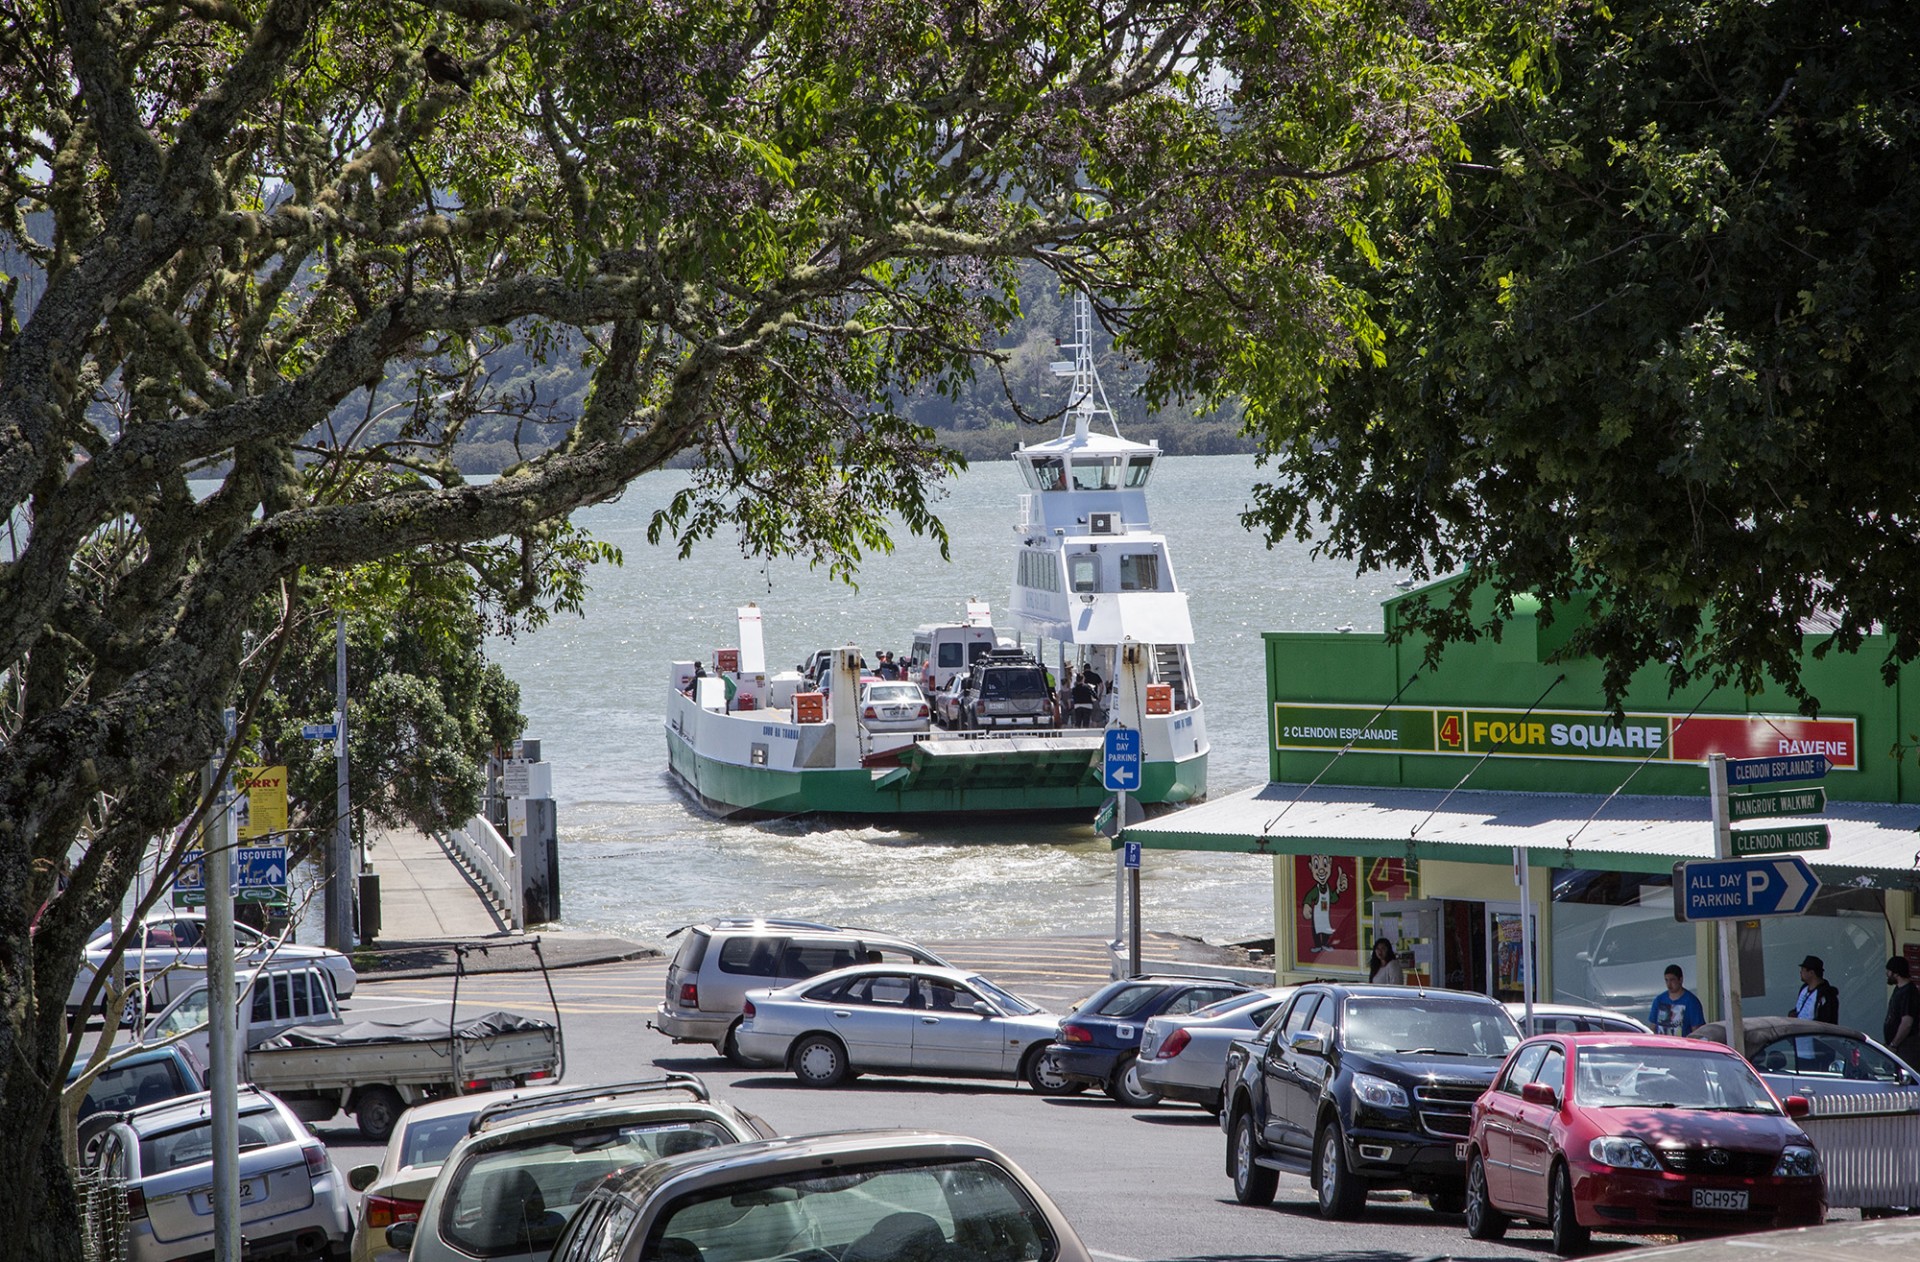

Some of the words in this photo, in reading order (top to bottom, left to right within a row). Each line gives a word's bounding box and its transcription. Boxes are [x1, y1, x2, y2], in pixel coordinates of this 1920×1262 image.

[1283, 726, 1290, 737] 2
[1291, 727, 1337, 739] CLENDON
[1339, 728, 1398, 741] ESPLANADE
[1440, 715, 1462, 748] 4
[1473, 721, 1546, 745] FOUR
[1550, 723, 1663, 750] SQUARE
[1116, 743, 1129, 751] DAY
[1778, 739, 1848, 756] RAWENE
[1108, 753, 1137, 762] PARKING
[1735, 764, 1770, 780] CLENDON
[1772, 760, 1814, 777] ESPLANADE
[237, 778, 281, 790] ERRY
[1735, 797, 1777, 815] MANGROVE
[1780, 794, 1816, 811] WALKWAY
[1130, 843, 1137, 854] P
[1737, 833, 1783, 851] CLENDON
[1787, 831, 1820, 847] HOUSE
[239, 849, 283, 861] ISCOVERY
[1691, 875, 1714, 889] ALL
[1719, 874, 1742, 888] DAY
[1746, 870, 1770, 906] P
[1692, 893, 1742, 908] PARKING
[1695, 1191, 1747, 1208] BCH957
